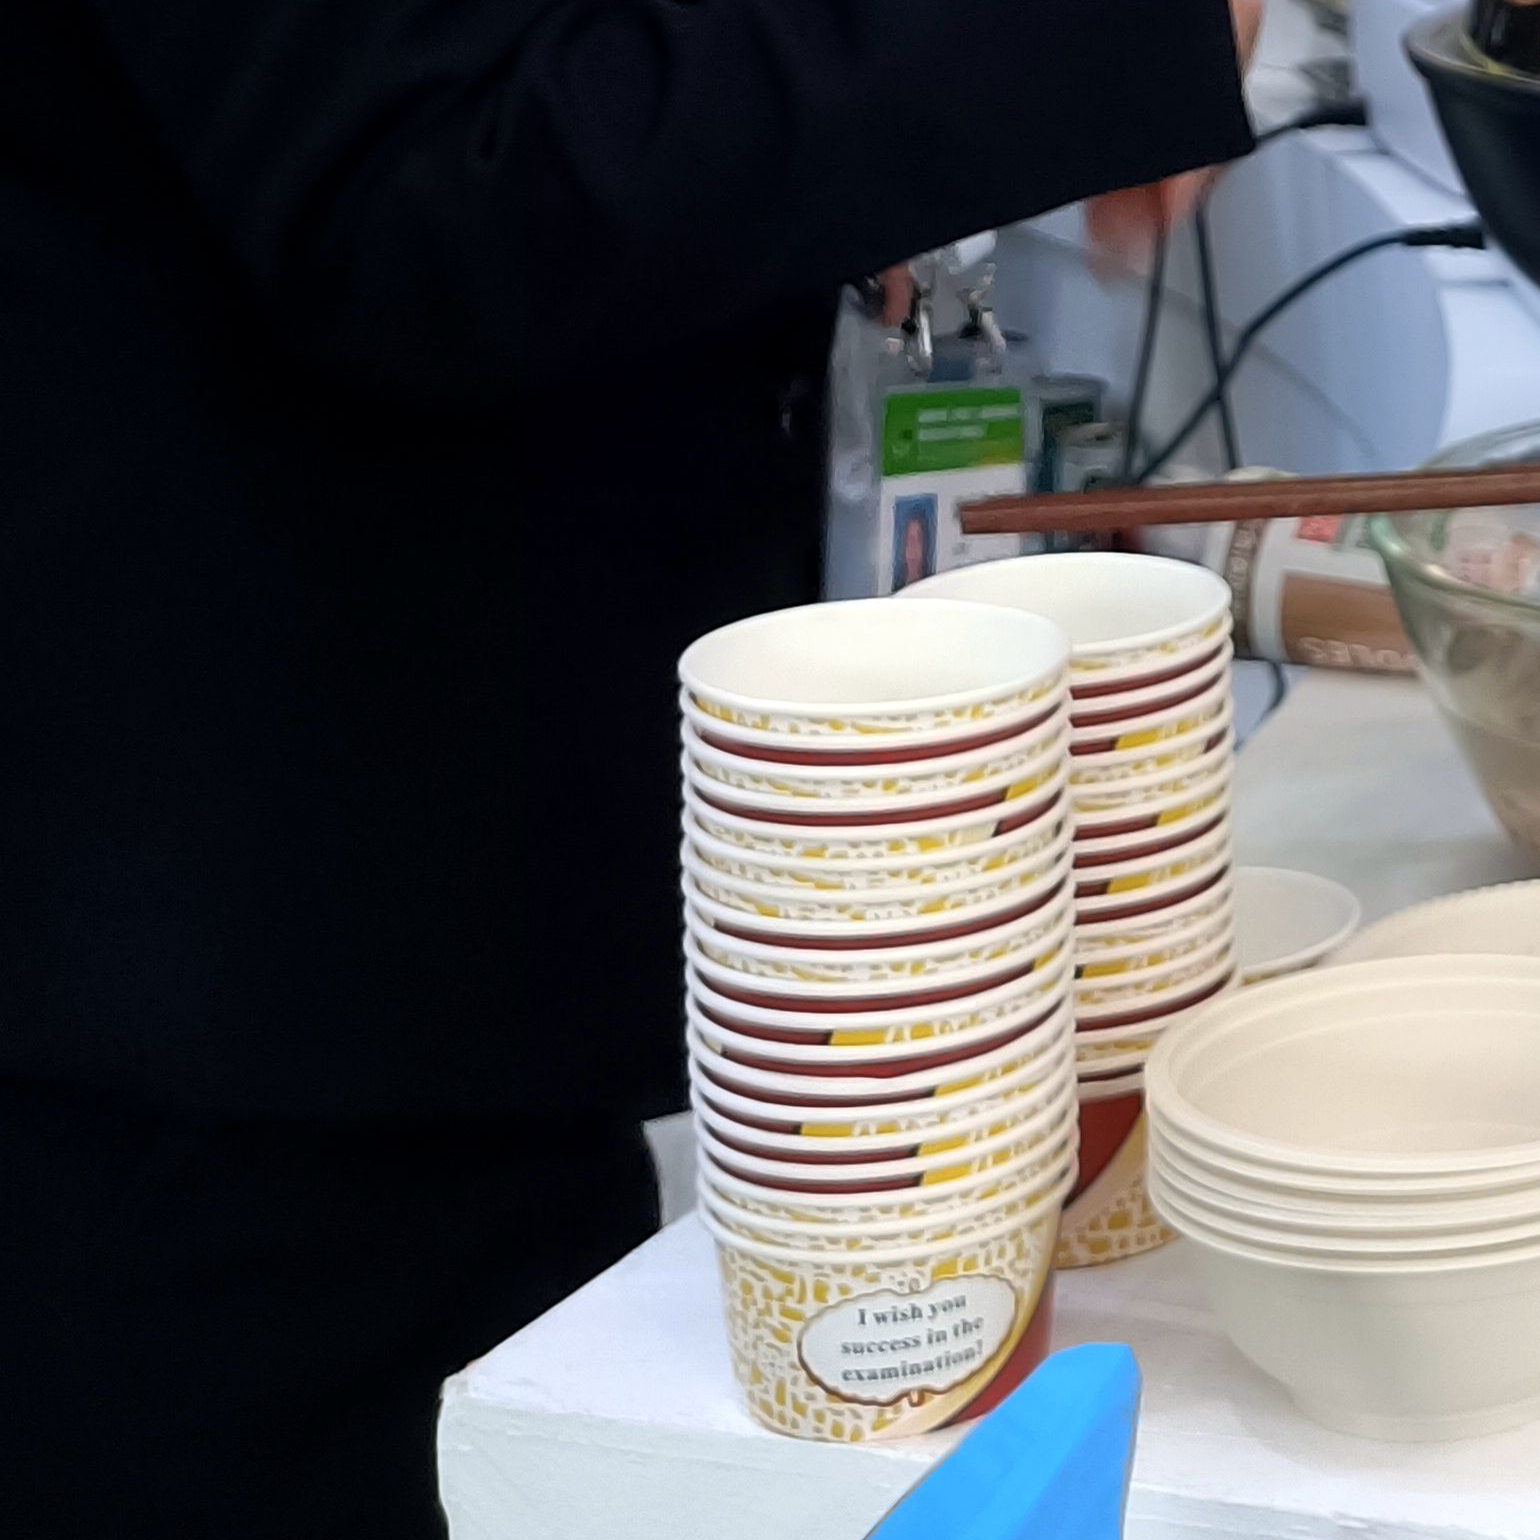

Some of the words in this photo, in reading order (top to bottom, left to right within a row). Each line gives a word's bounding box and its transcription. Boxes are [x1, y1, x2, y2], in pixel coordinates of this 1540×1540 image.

[857, 1308, 868, 1326] I
[873, 1303, 924, 1325] wish
[927, 1293, 968, 1320] you
[840, 1333, 922, 1356] success
[926, 1327, 949, 1345] in
[952, 1315, 985, 1338] the
[840, 1338, 984, 1383] examination!
